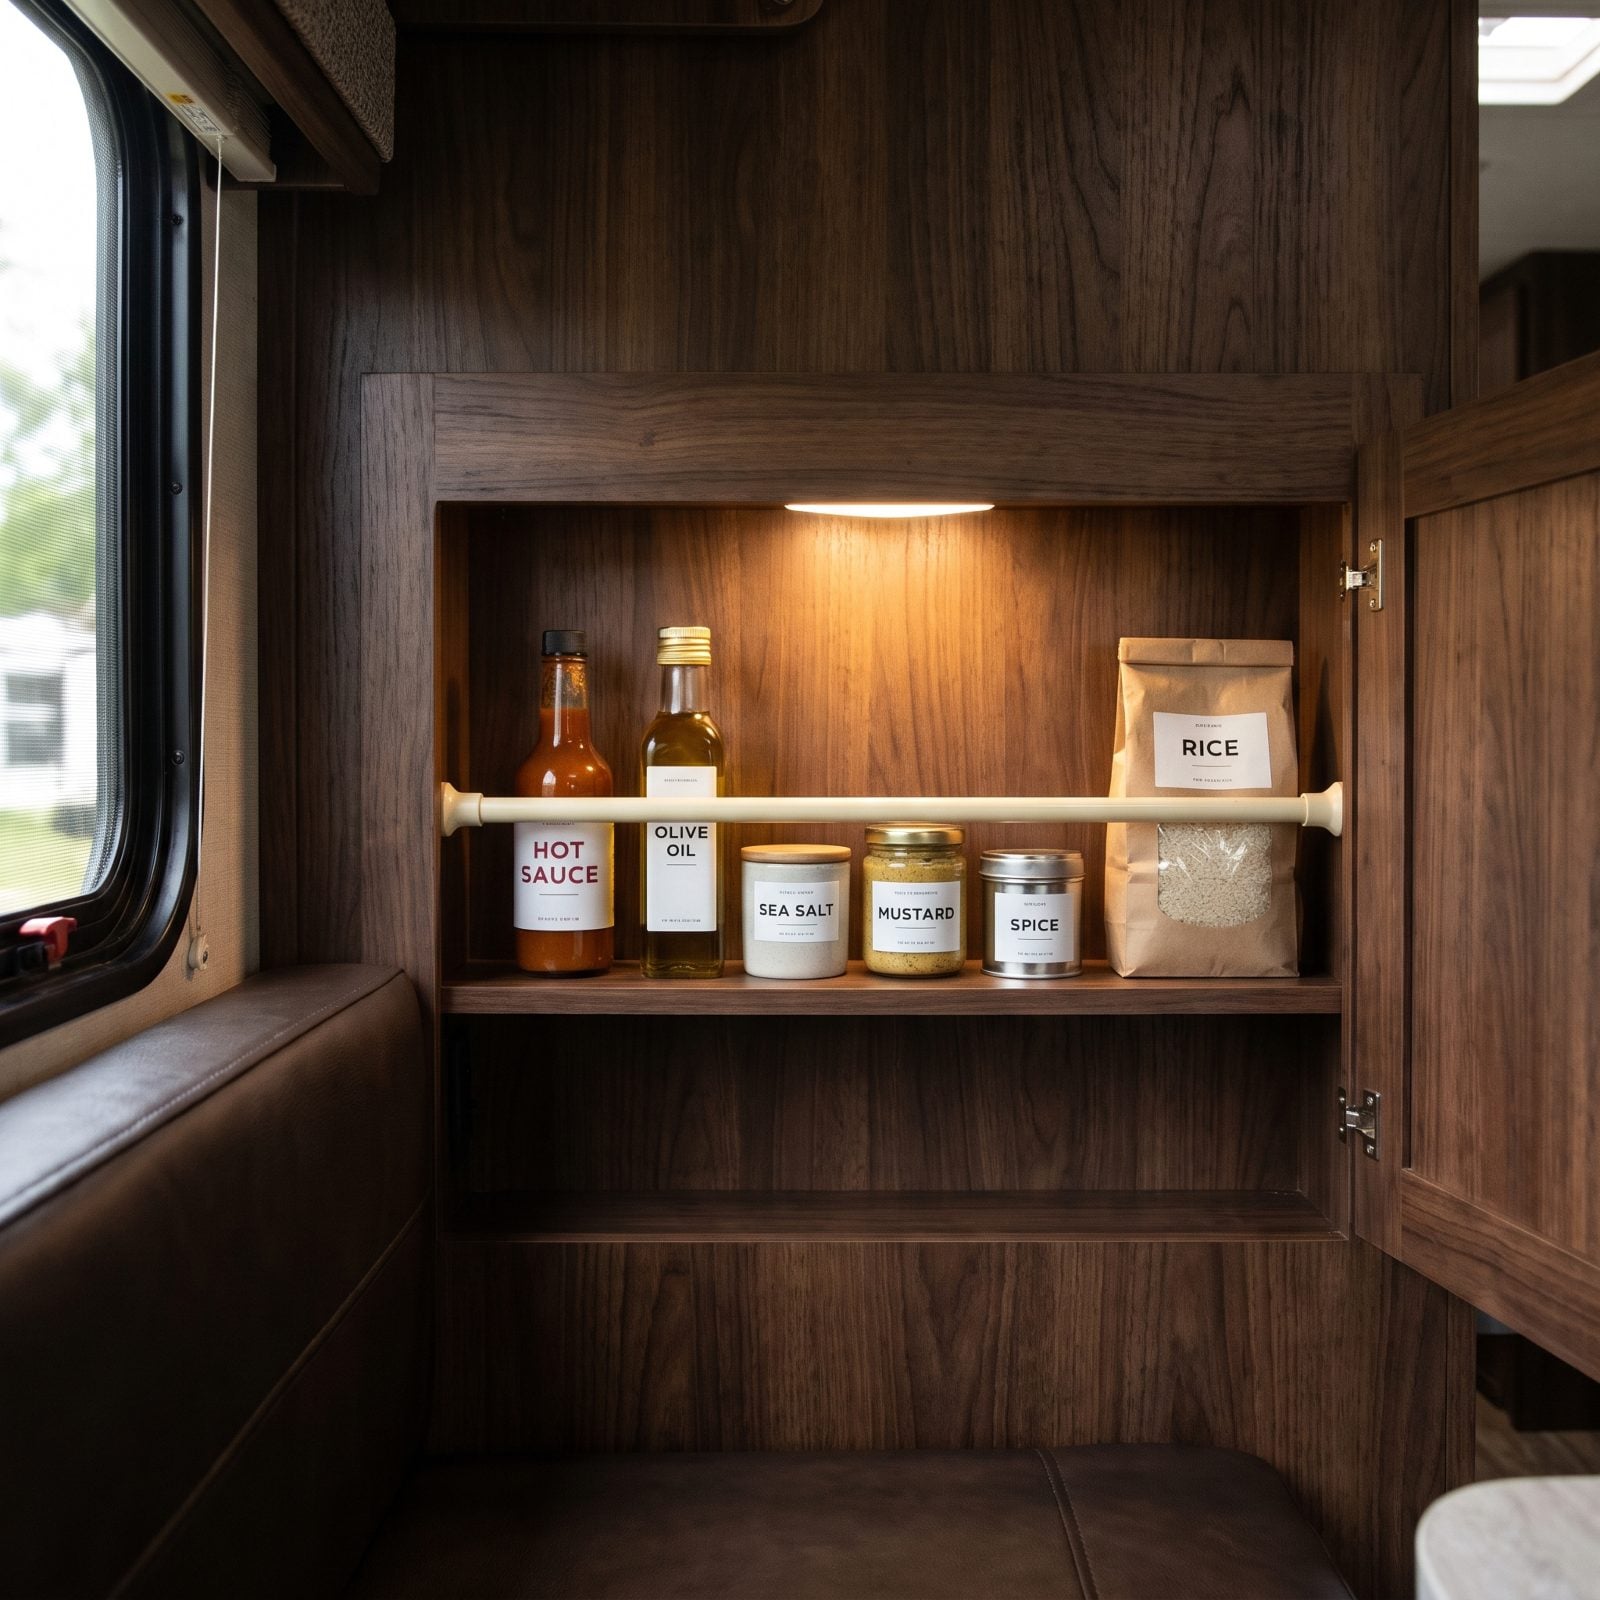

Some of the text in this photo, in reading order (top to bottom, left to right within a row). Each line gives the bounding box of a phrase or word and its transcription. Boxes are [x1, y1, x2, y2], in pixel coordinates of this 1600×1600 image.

[1182, 738, 1239, 757] RICE
[654, 825, 709, 839] OLIVE
[533, 841, 585, 859] HOT
[666, 844, 696, 857] OIL
[521, 865, 598, 884] SAUCE
[759, 903, 834, 917] SEA SALT
[878, 906, 955, 921] MUSTARD
[1010, 918, 1059, 932] SPICE
